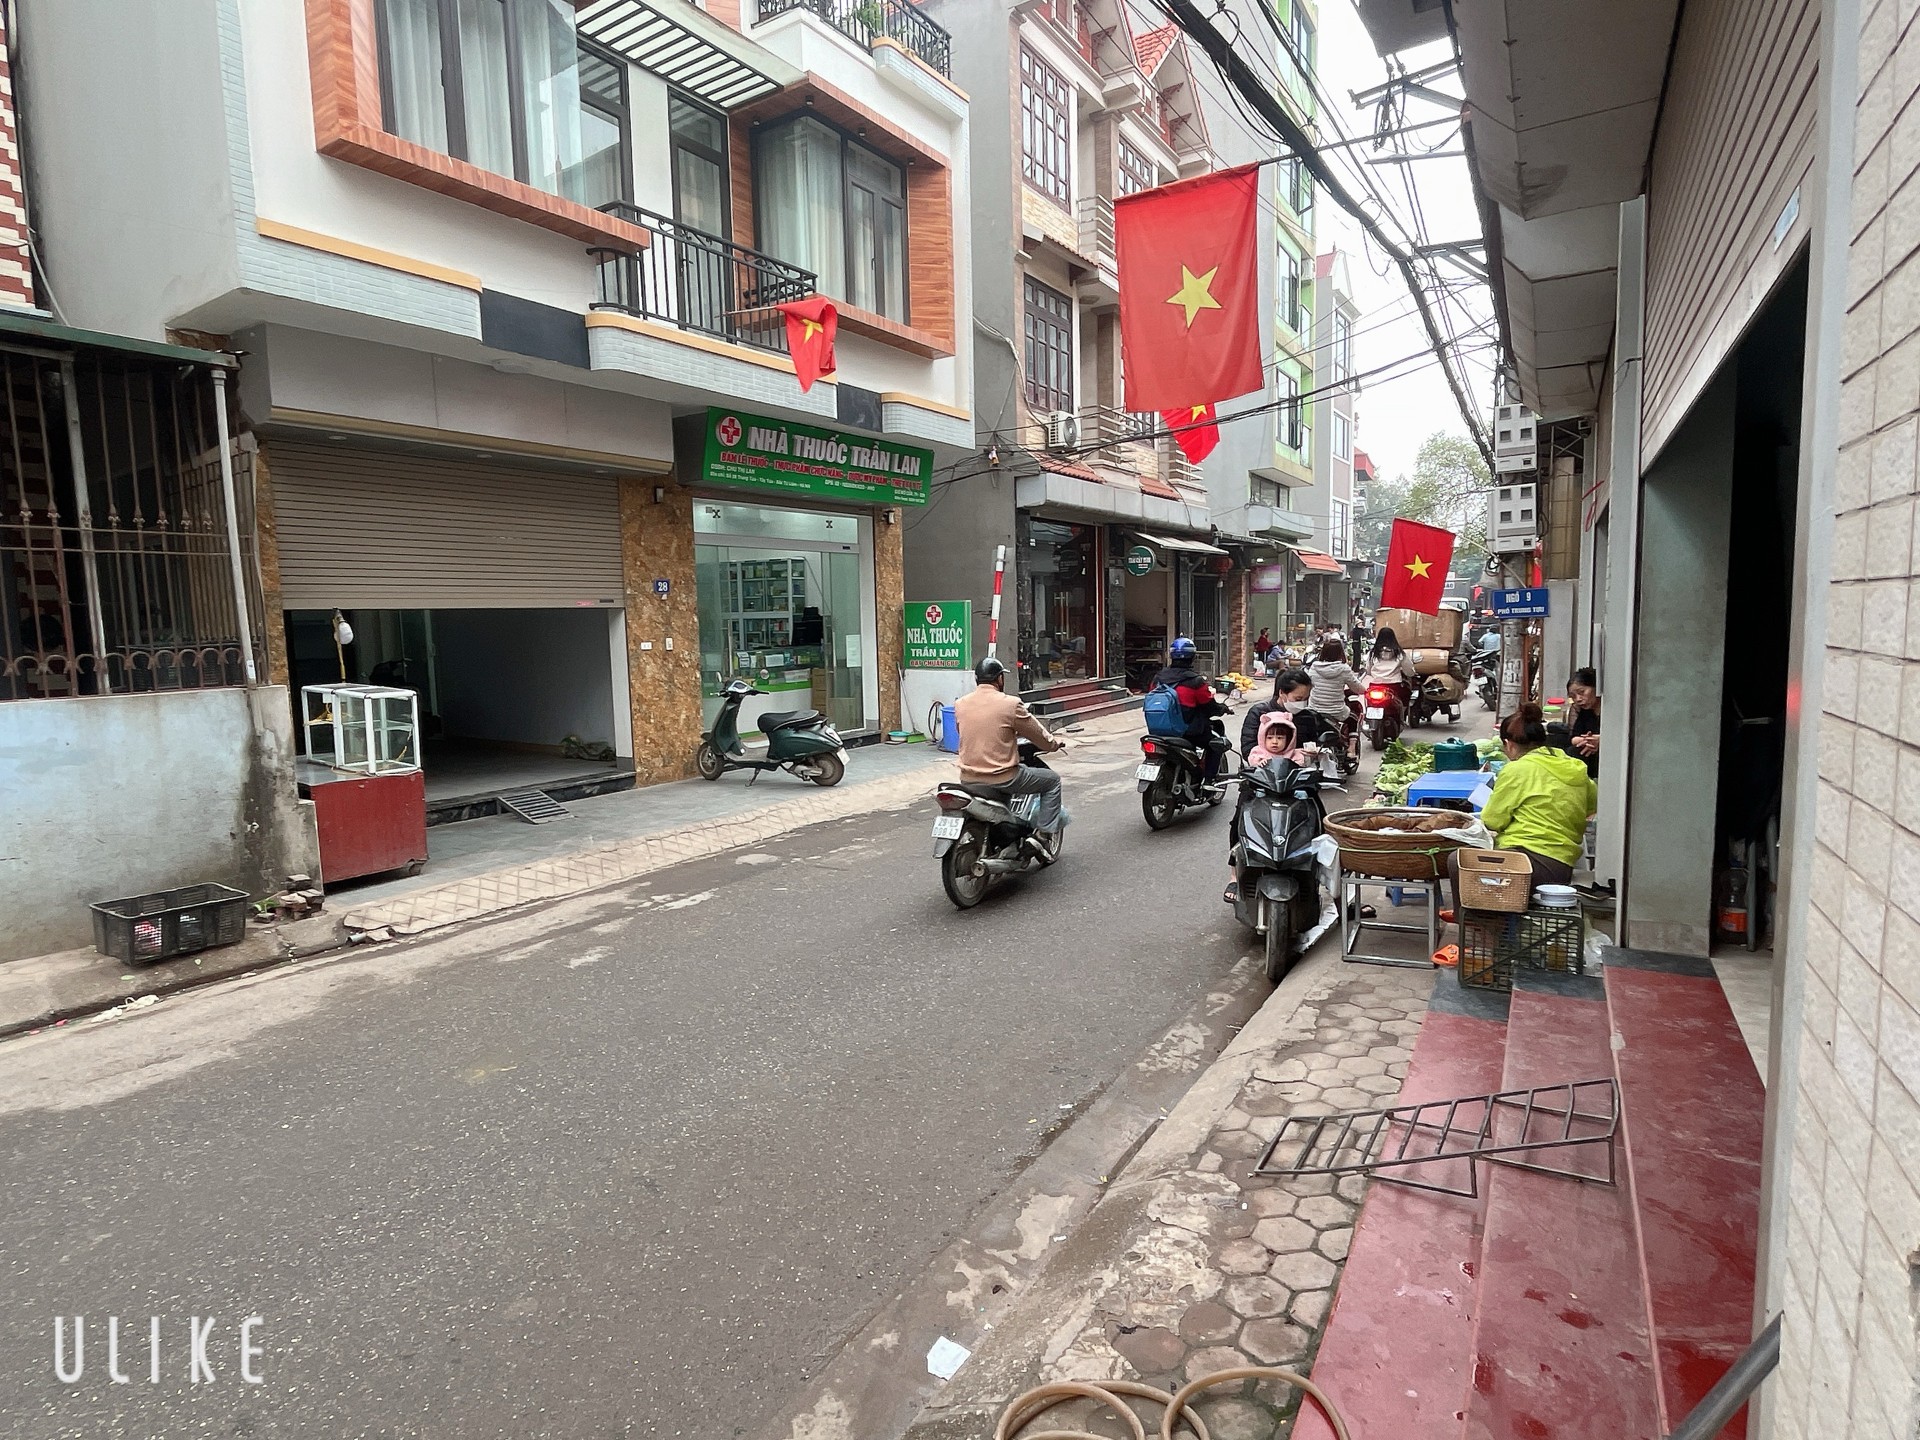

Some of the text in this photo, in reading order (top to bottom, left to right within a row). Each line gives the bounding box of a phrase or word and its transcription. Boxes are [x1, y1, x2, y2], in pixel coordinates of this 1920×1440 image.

[747, 426, 789, 455] NHÀ
[792, 434, 848, 465] THUỐC
[889, 453, 921, 476] LAN
[658, 581, 668, 592] 28
[1526, 591, 1532, 602] 9
[906, 620, 963, 644] NHÀ THUỐC
[939, 648, 959, 657] LAN
